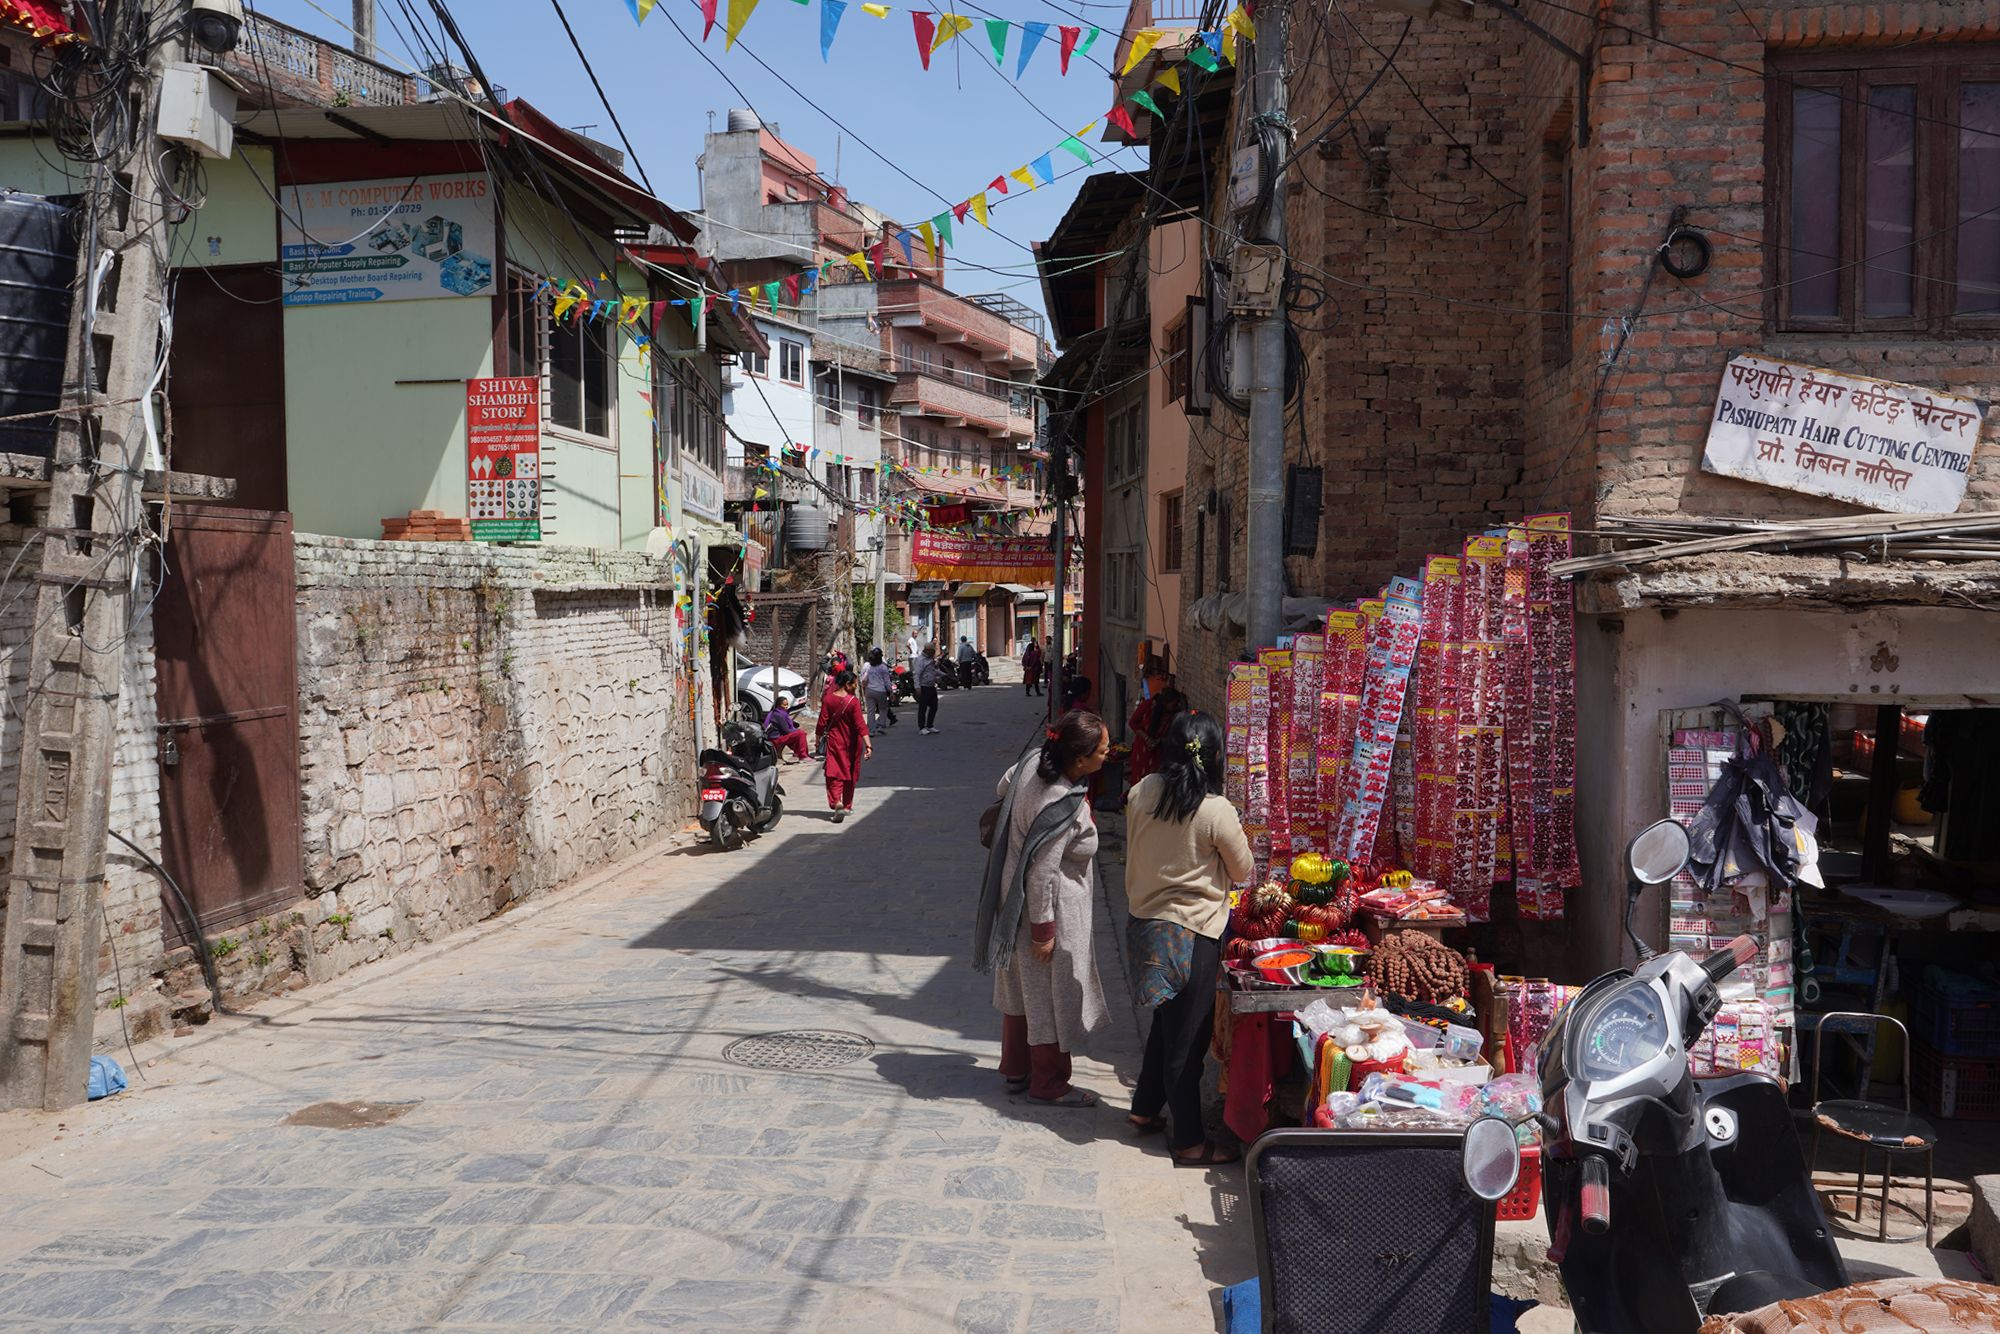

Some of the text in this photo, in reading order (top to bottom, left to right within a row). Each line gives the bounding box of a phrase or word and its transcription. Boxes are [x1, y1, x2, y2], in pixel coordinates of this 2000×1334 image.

[320, 190, 333, 208] M
[338, 184, 424, 207] COMPUTER
[429, 179, 487, 201] WORKS
[351, 207, 366, 217] Ph:
[343, 257, 367, 269] Supply
[368, 256, 401, 267] Repairing
[310, 276, 338, 286] Desktop
[340, 274, 365, 284] Mother
[367, 272, 388, 282] Board
[389, 271, 422, 282] Repairing
[289, 289, 376, 304] Laptop Repairing Training
[479, 380, 529, 393] SHIVA
[469, 393, 537, 406] SHAMBHU
[481, 406, 527, 419] STORE
[1717, 398, 1971, 473] PASHUPATI HAIR CUTTING CENTRE
[1856, 458, 1913, 492] नापित
